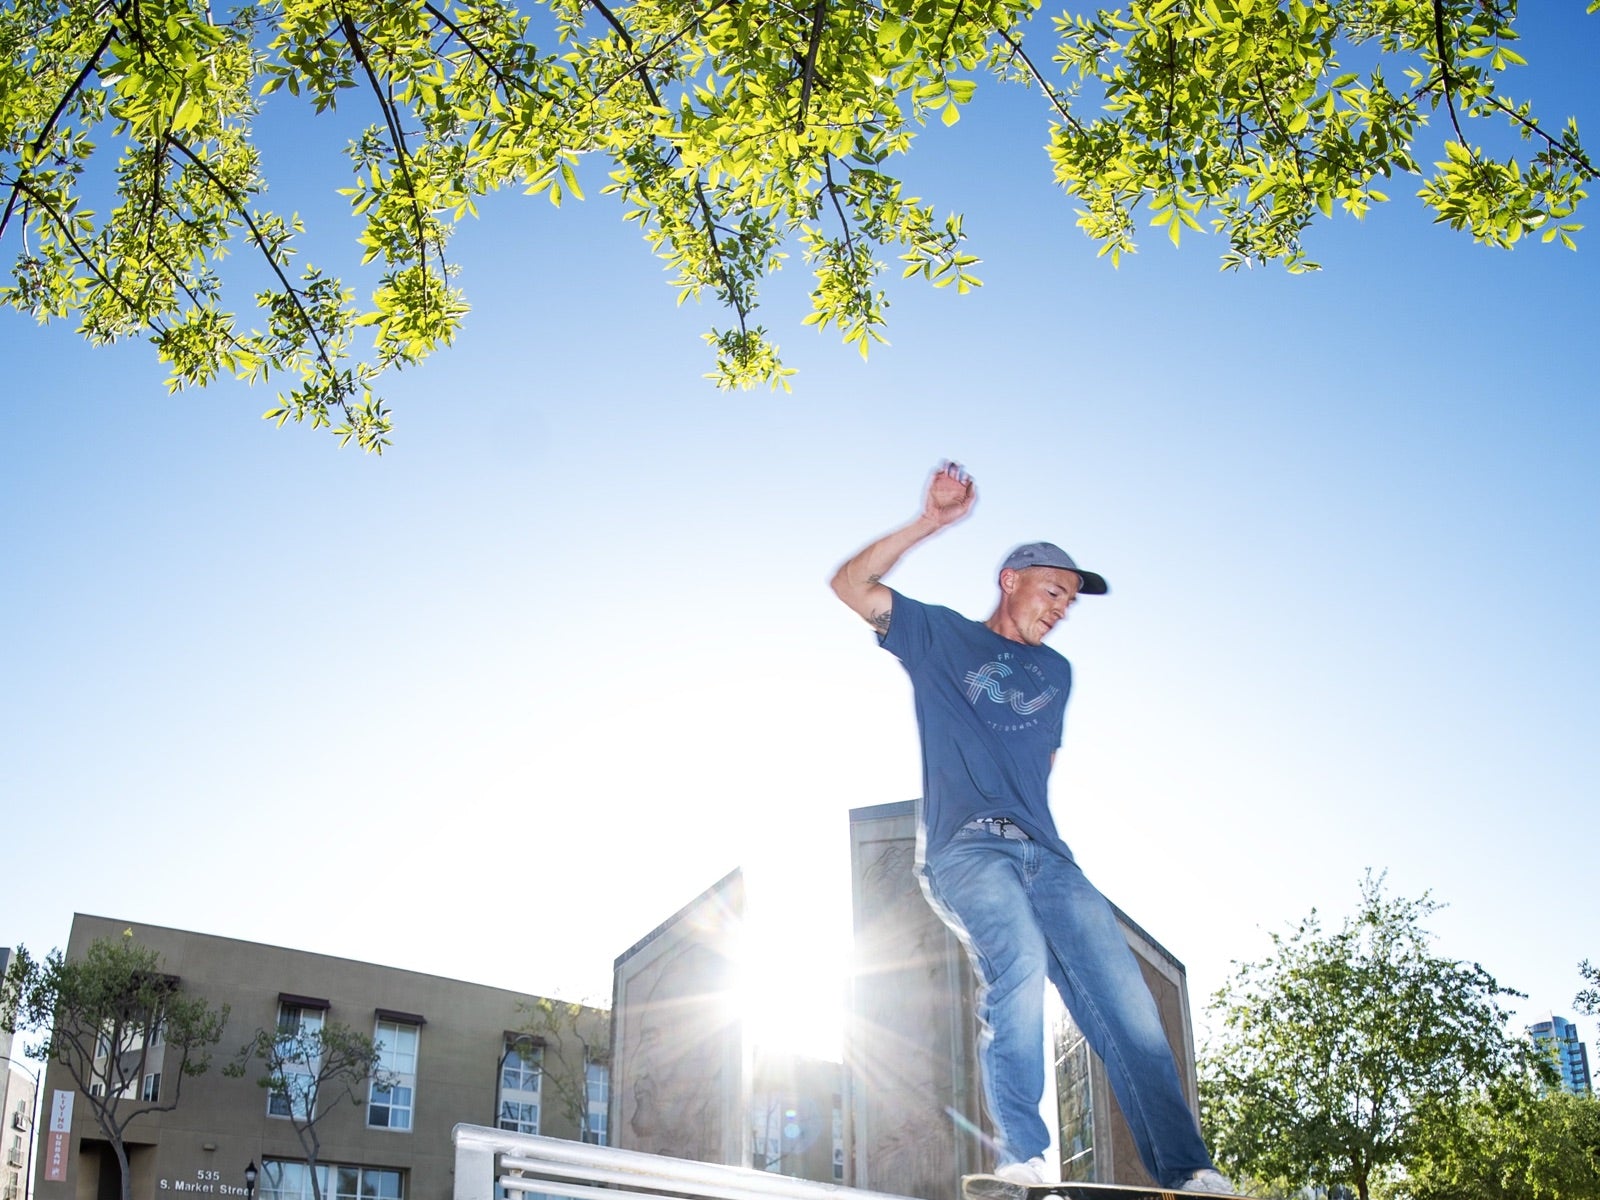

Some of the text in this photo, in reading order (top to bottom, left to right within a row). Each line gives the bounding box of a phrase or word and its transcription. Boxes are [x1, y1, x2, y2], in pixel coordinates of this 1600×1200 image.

[53, 1093, 66, 1166] LIVING URBAN
[197, 1170, 220, 1181] 535
[160, 1179, 171, 1190] S.
[175, 1180, 214, 1193] Market
